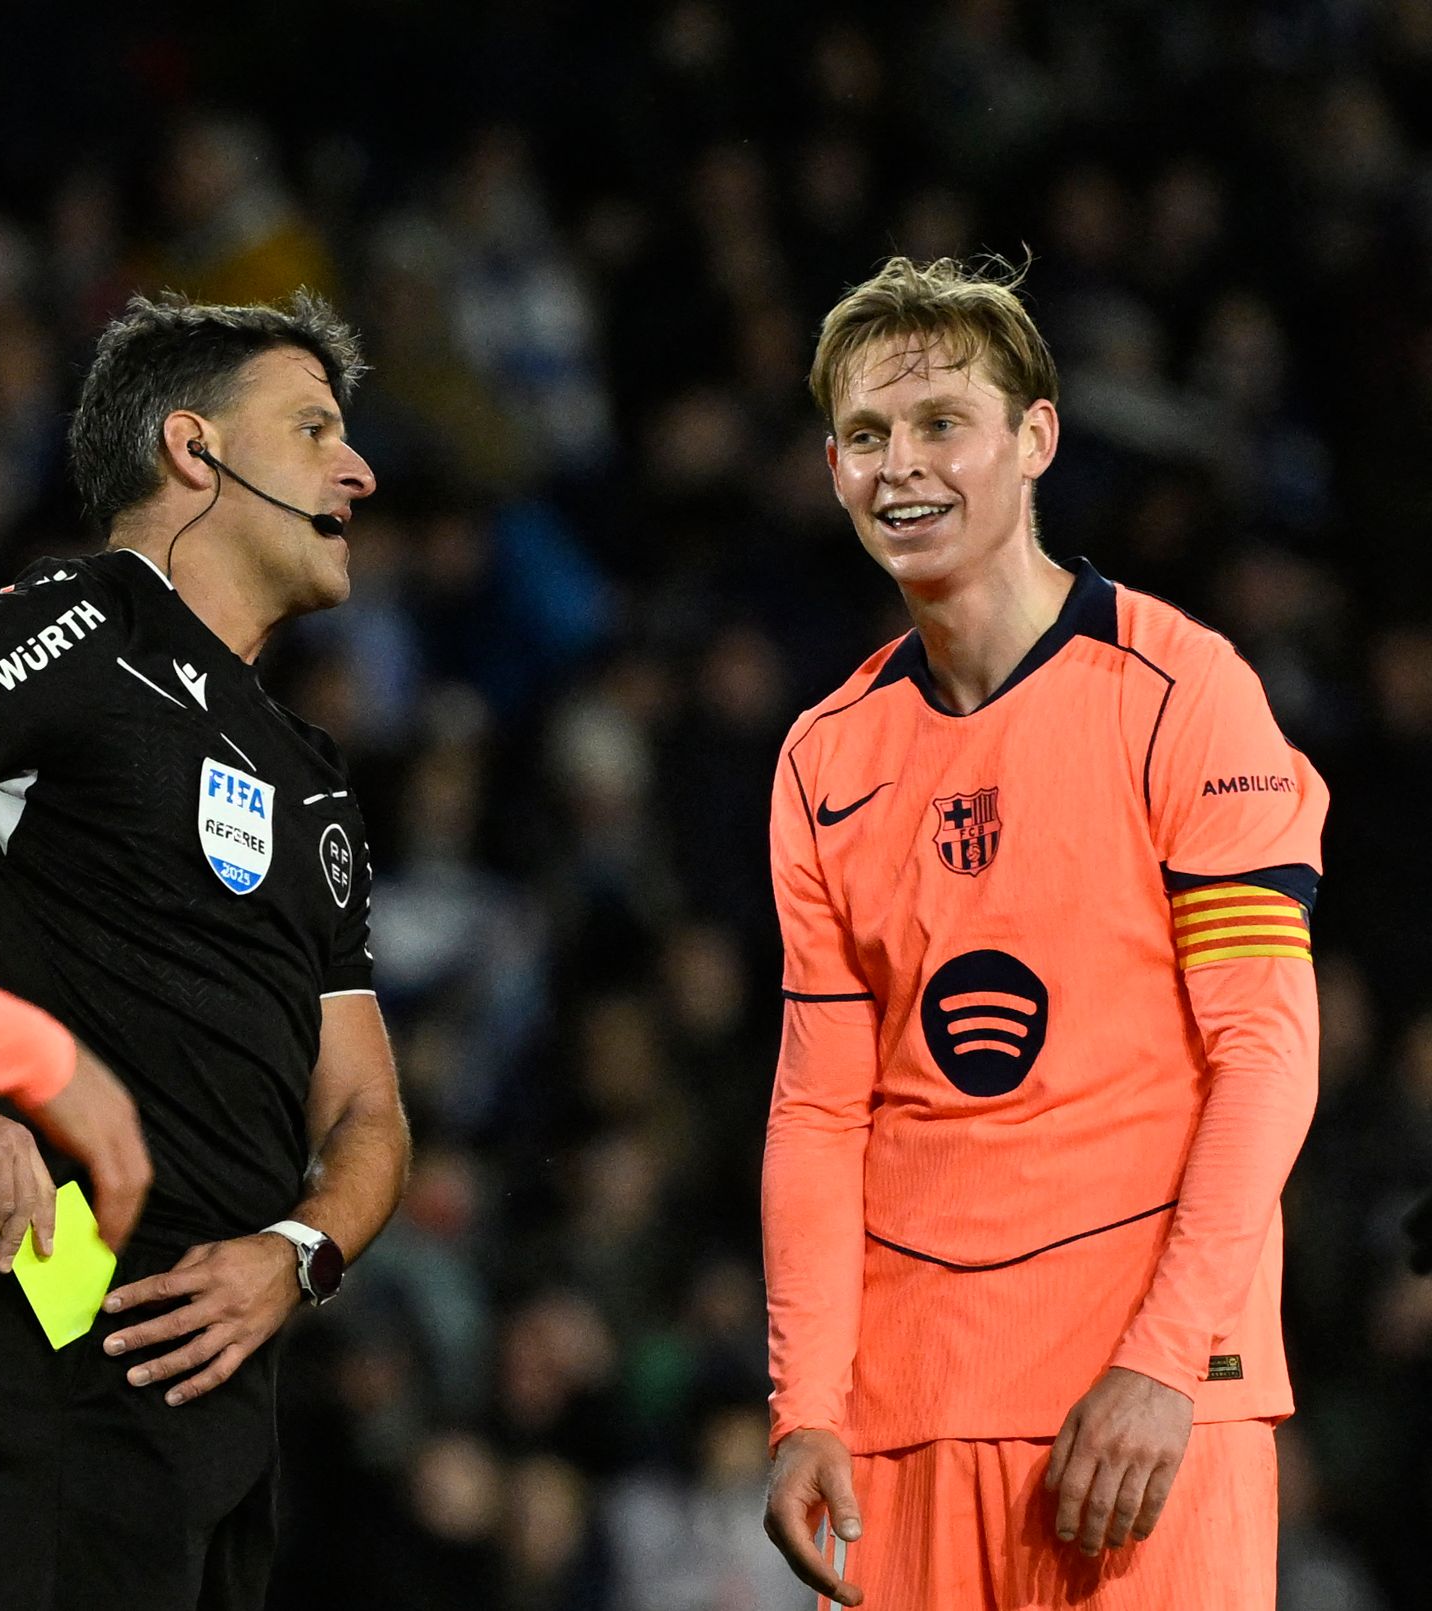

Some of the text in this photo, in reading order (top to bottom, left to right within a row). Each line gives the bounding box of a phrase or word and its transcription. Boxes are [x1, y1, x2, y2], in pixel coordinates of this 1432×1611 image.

[208, 768, 265, 819] FIFA
[205, 818, 266, 855] REFEREE
[960, 825, 984, 841] FCB
[220, 862, 252, 886] 2025
